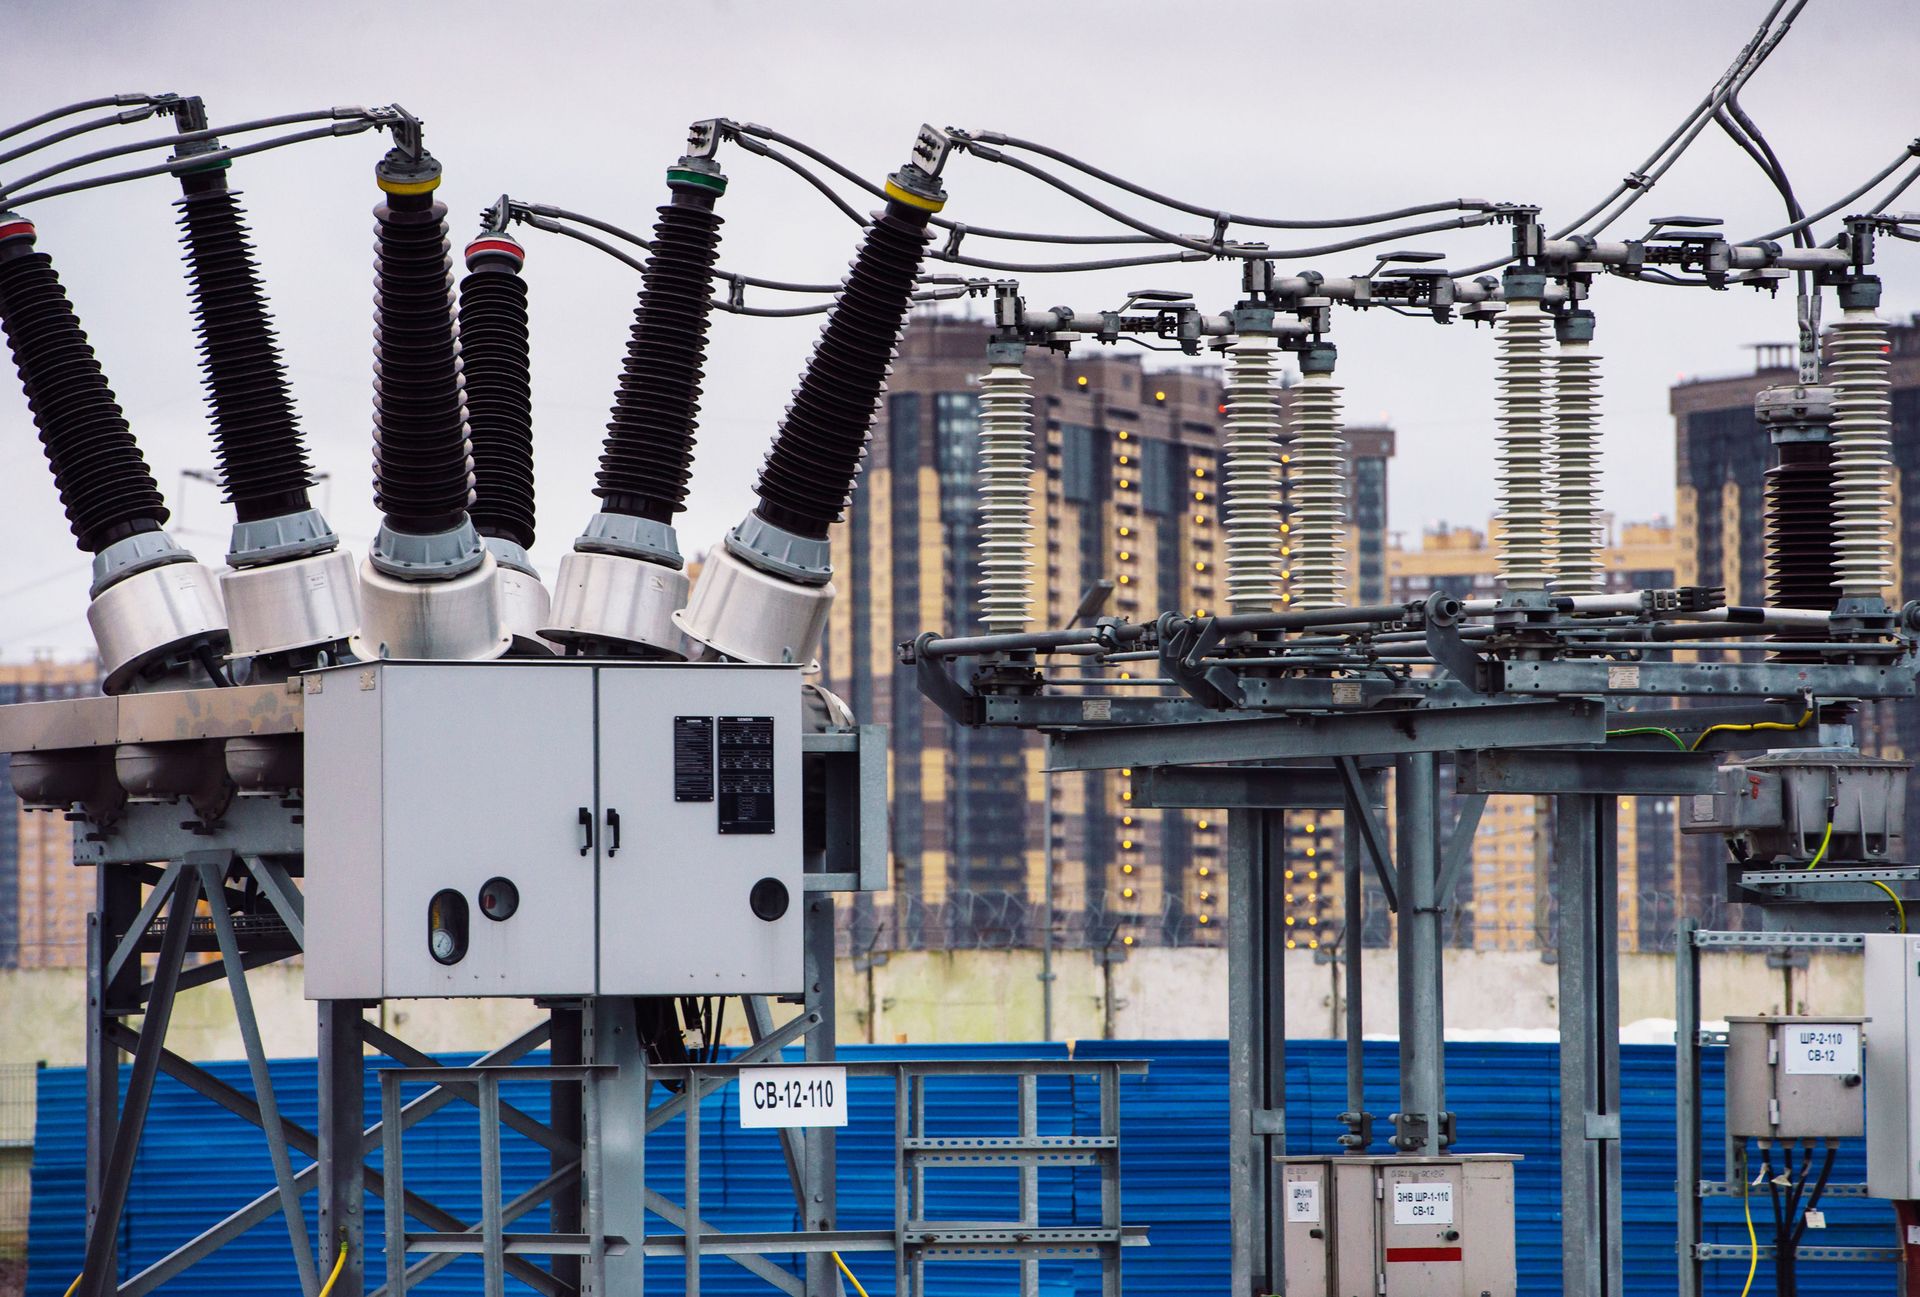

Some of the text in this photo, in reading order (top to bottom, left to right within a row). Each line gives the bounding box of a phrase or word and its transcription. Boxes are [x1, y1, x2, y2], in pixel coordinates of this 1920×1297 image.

[1800, 1032, 1843, 1045] ШР-2-110
[1808, 1049, 1835, 1062] СВ-12
[753, 1080, 834, 1109] СВ-12-110
[1397, 1191, 1449, 1203] ЗНВ ШР-1-110
[1412, 1206, 1435, 1216] СВ-12
